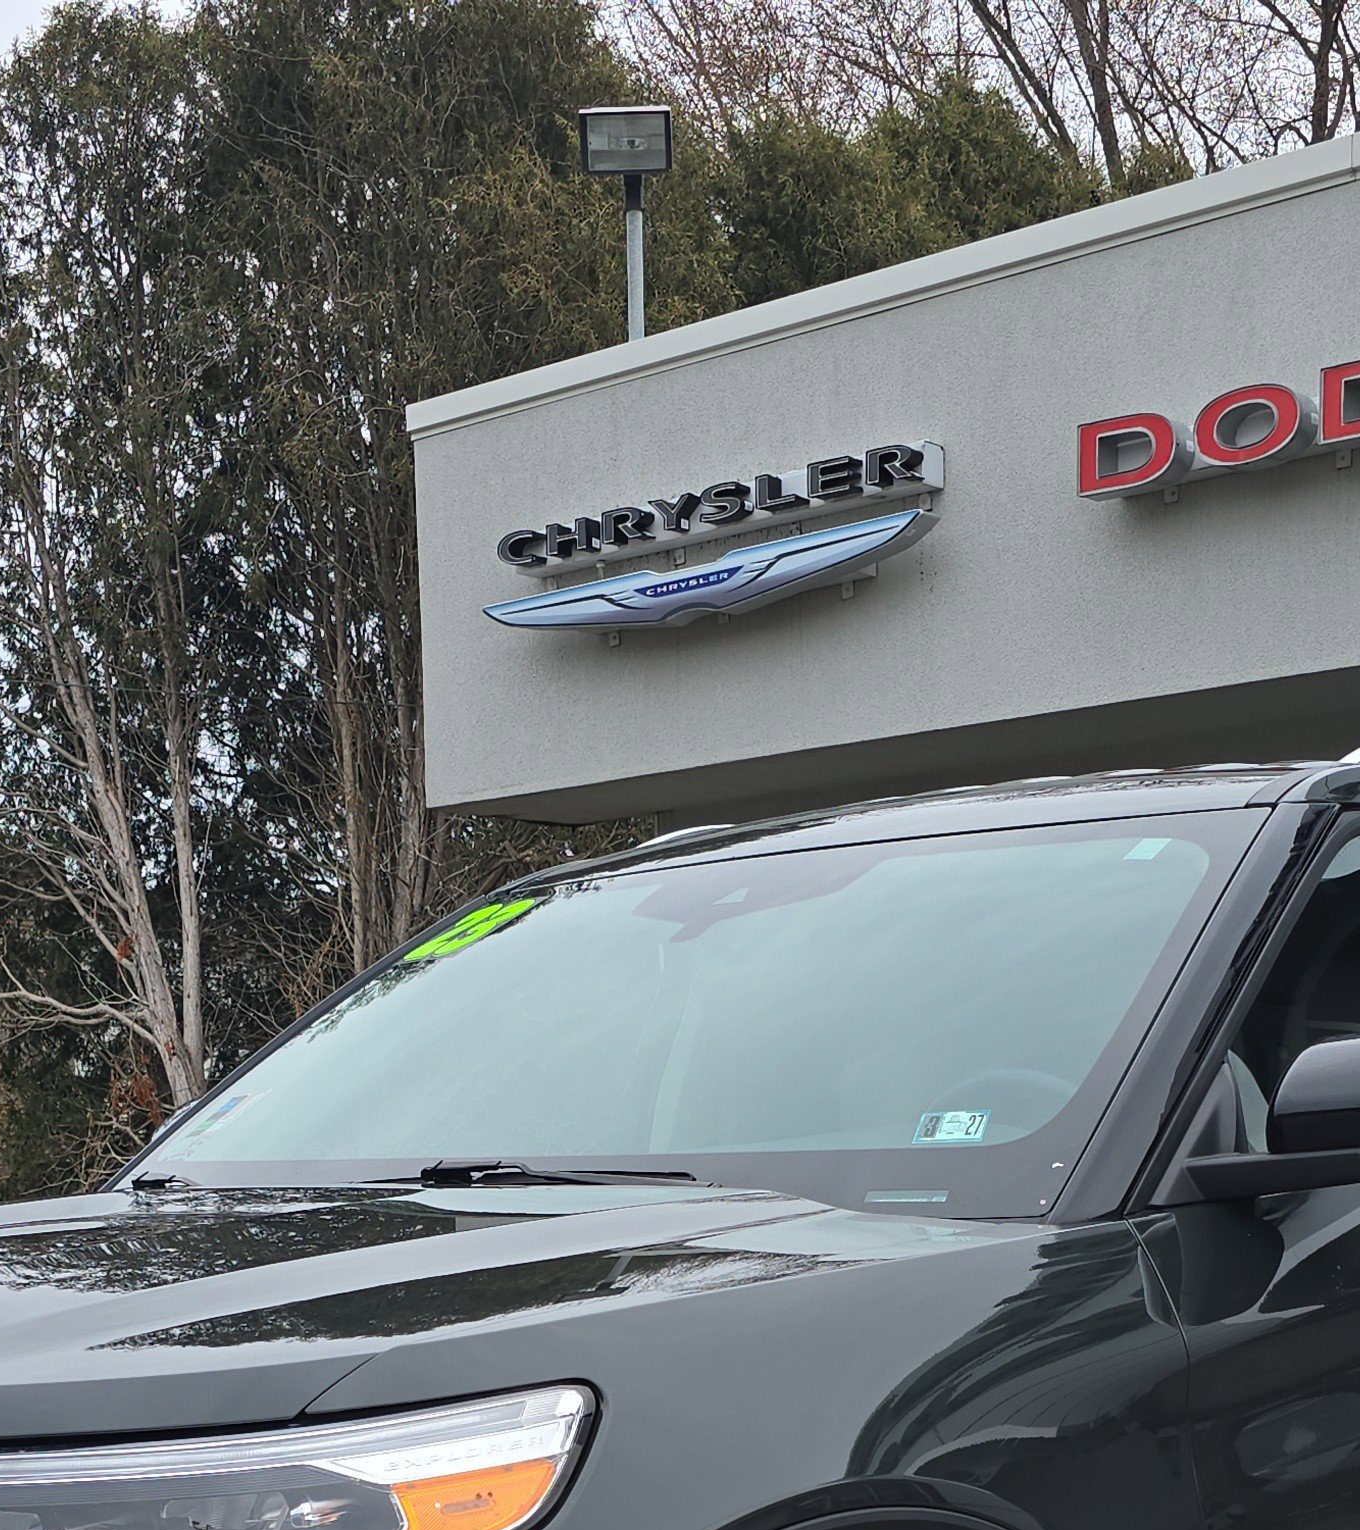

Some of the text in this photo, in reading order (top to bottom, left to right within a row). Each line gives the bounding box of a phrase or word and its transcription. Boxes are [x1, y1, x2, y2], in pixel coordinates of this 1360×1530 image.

[497, 444, 924, 567] CHRYSLER
[646, 572, 729, 596] CHRYSLER
[965, 1114, 985, 1136] 27
[384, 1436, 543, 1472] EXPLORER
